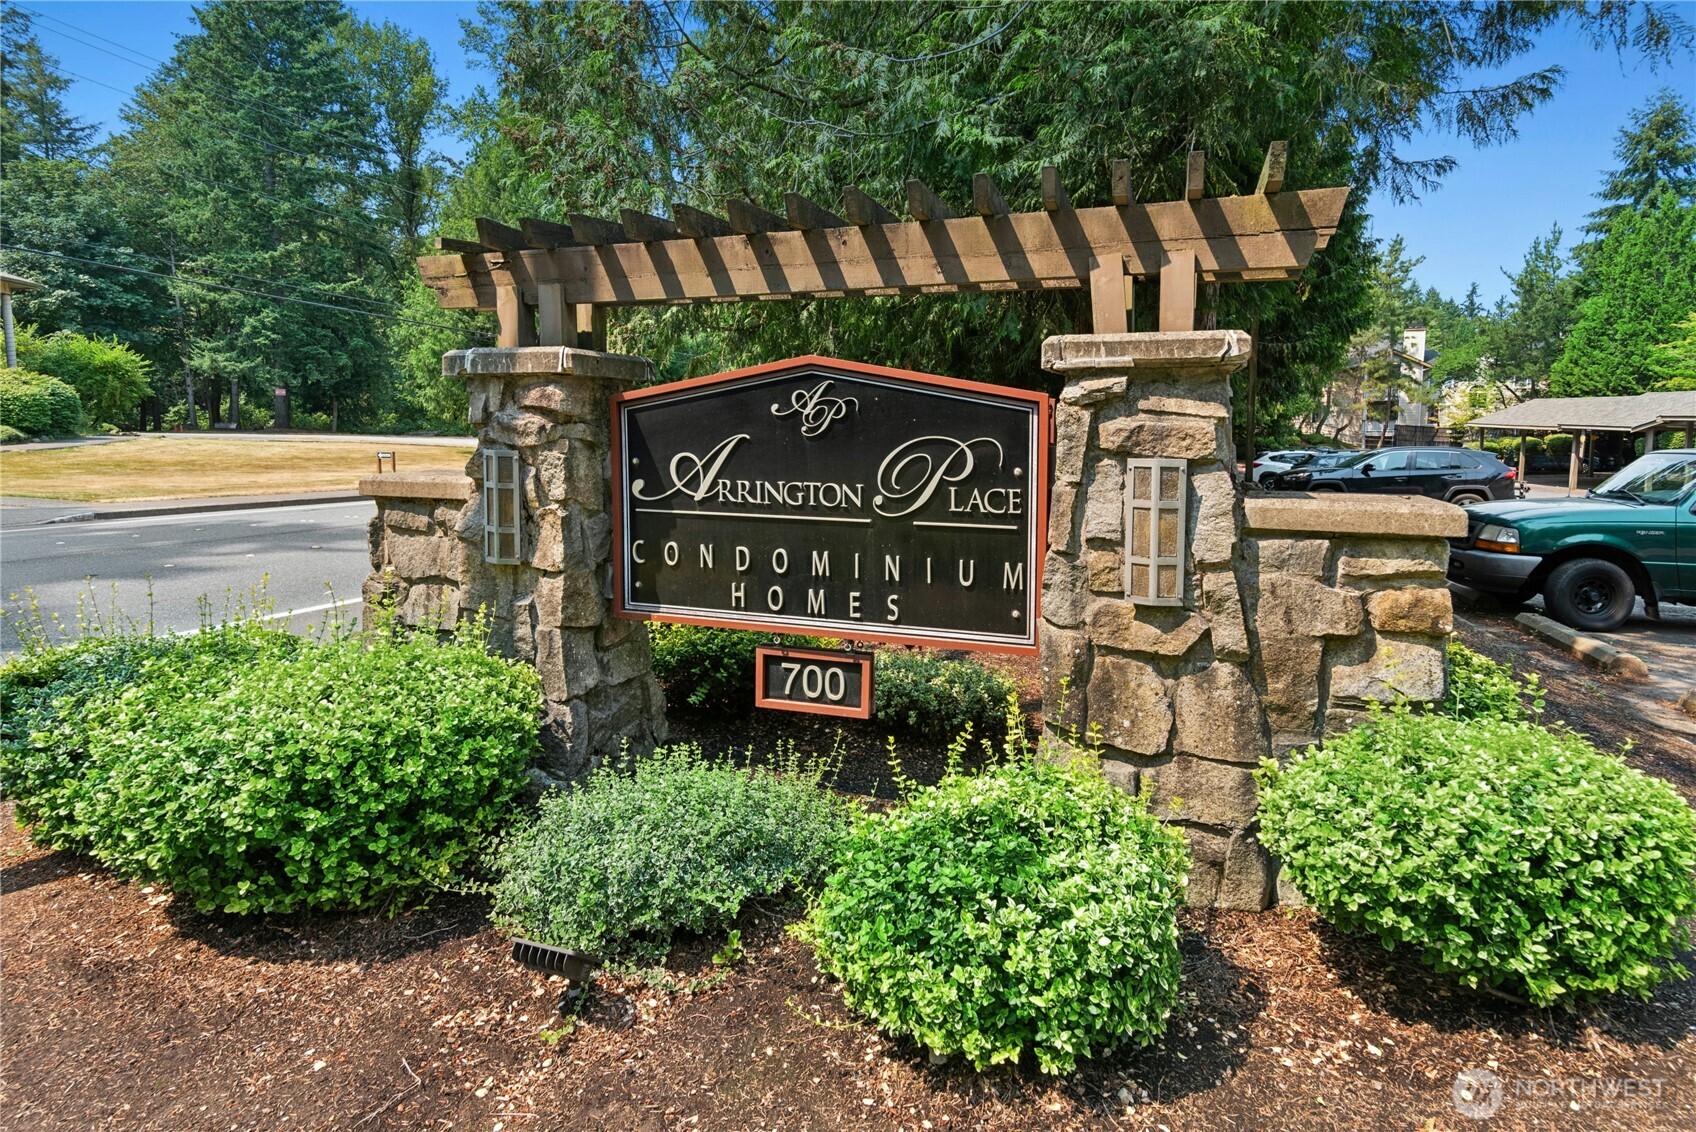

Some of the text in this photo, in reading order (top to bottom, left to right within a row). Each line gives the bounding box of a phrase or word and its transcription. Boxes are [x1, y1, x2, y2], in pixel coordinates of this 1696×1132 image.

[631, 433, 1022, 517] ARRINGTON PLACE
[632, 539, 1024, 591] CONDOMINIUM
[731, 582, 899, 622] HOMES
[781, 662, 845, 701] 700
